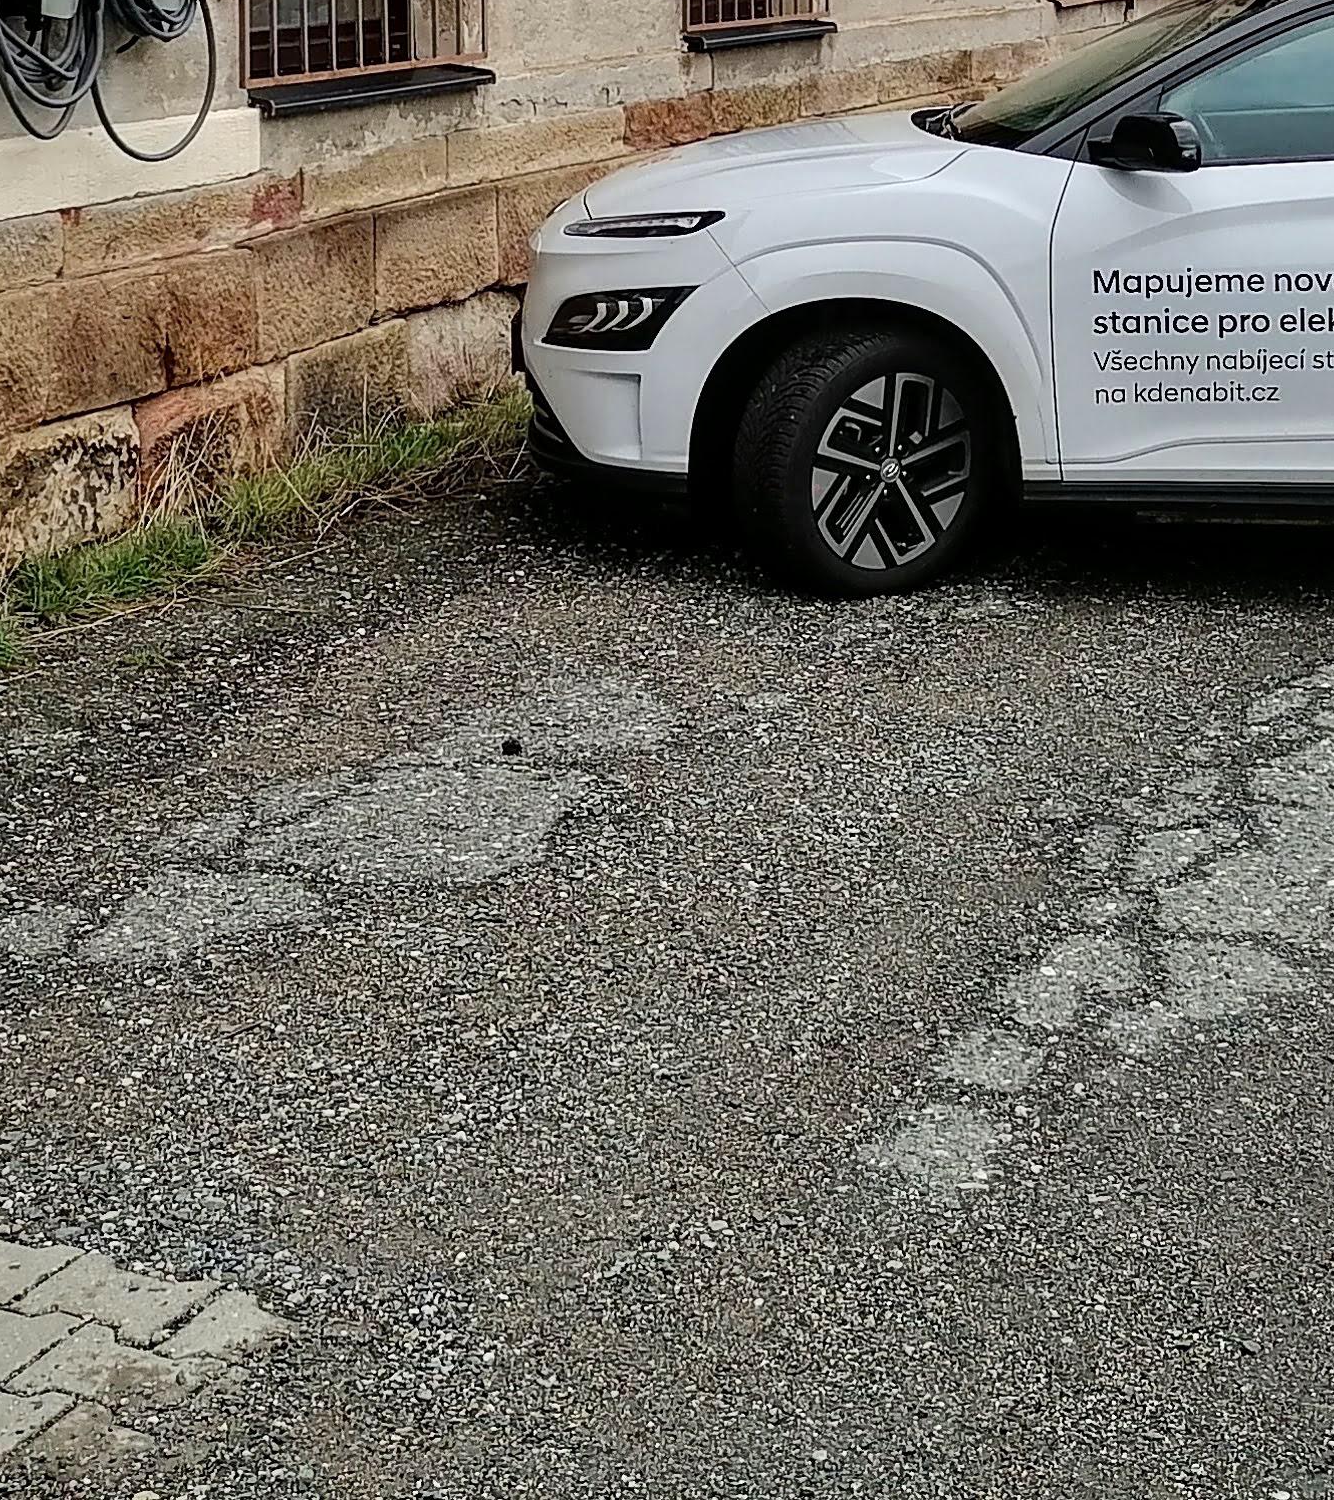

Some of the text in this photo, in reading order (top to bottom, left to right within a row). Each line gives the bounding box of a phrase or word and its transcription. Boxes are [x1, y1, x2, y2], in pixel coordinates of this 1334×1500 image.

[1093, 267, 1264, 298] Mapujeme
[1093, 308, 1209, 334] stanice
[1219, 314, 1270, 339] pro
[1093, 350, 1199, 375] Všechny
[1206, 349, 1305, 375] nabíjecí
[1095, 381, 1281, 404] na kdenabit.cz
